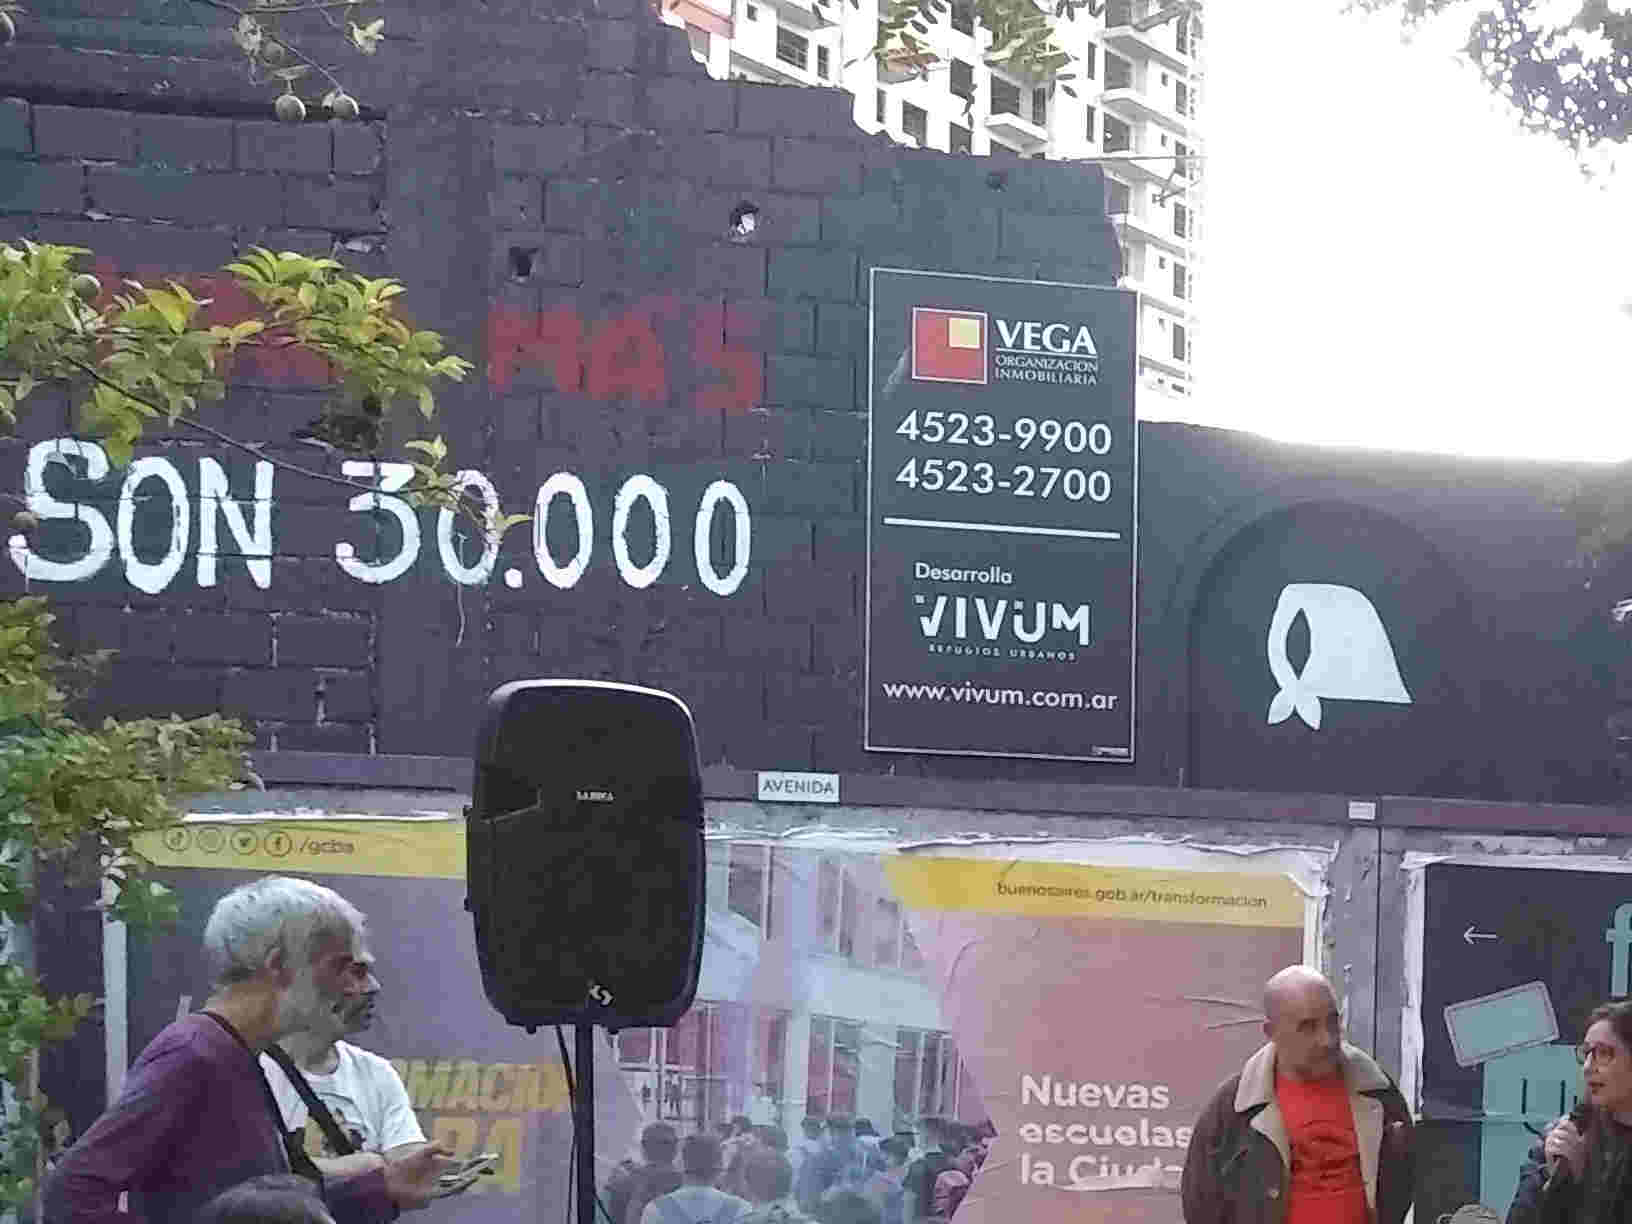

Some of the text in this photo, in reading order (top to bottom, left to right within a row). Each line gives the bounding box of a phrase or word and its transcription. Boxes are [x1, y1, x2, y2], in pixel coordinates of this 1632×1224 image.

[994, 319, 1098, 354] VEGA
[994, 368, 1097, 386] INMOBILIARIA
[896, 409, 1113, 455] 4523-9900
[896, 457, 1112, 502] 4523-2700
[8, 438, 752, 596] SON 30.000
[915, 562, 1013, 584] Desarrolla
[915, 595, 1090, 646] VIVUM
[929, 644, 1076, 661] REFUGIOS URBANOS
[882, 681, 1118, 710] www.vivum.com.ar
[762, 779, 835, 794] AVENIDA
[1021, 1074, 1171, 1109] Nuevas
[1019, 1117, 1194, 1149] escuelas
[1020, 1152, 1055, 1185] la
